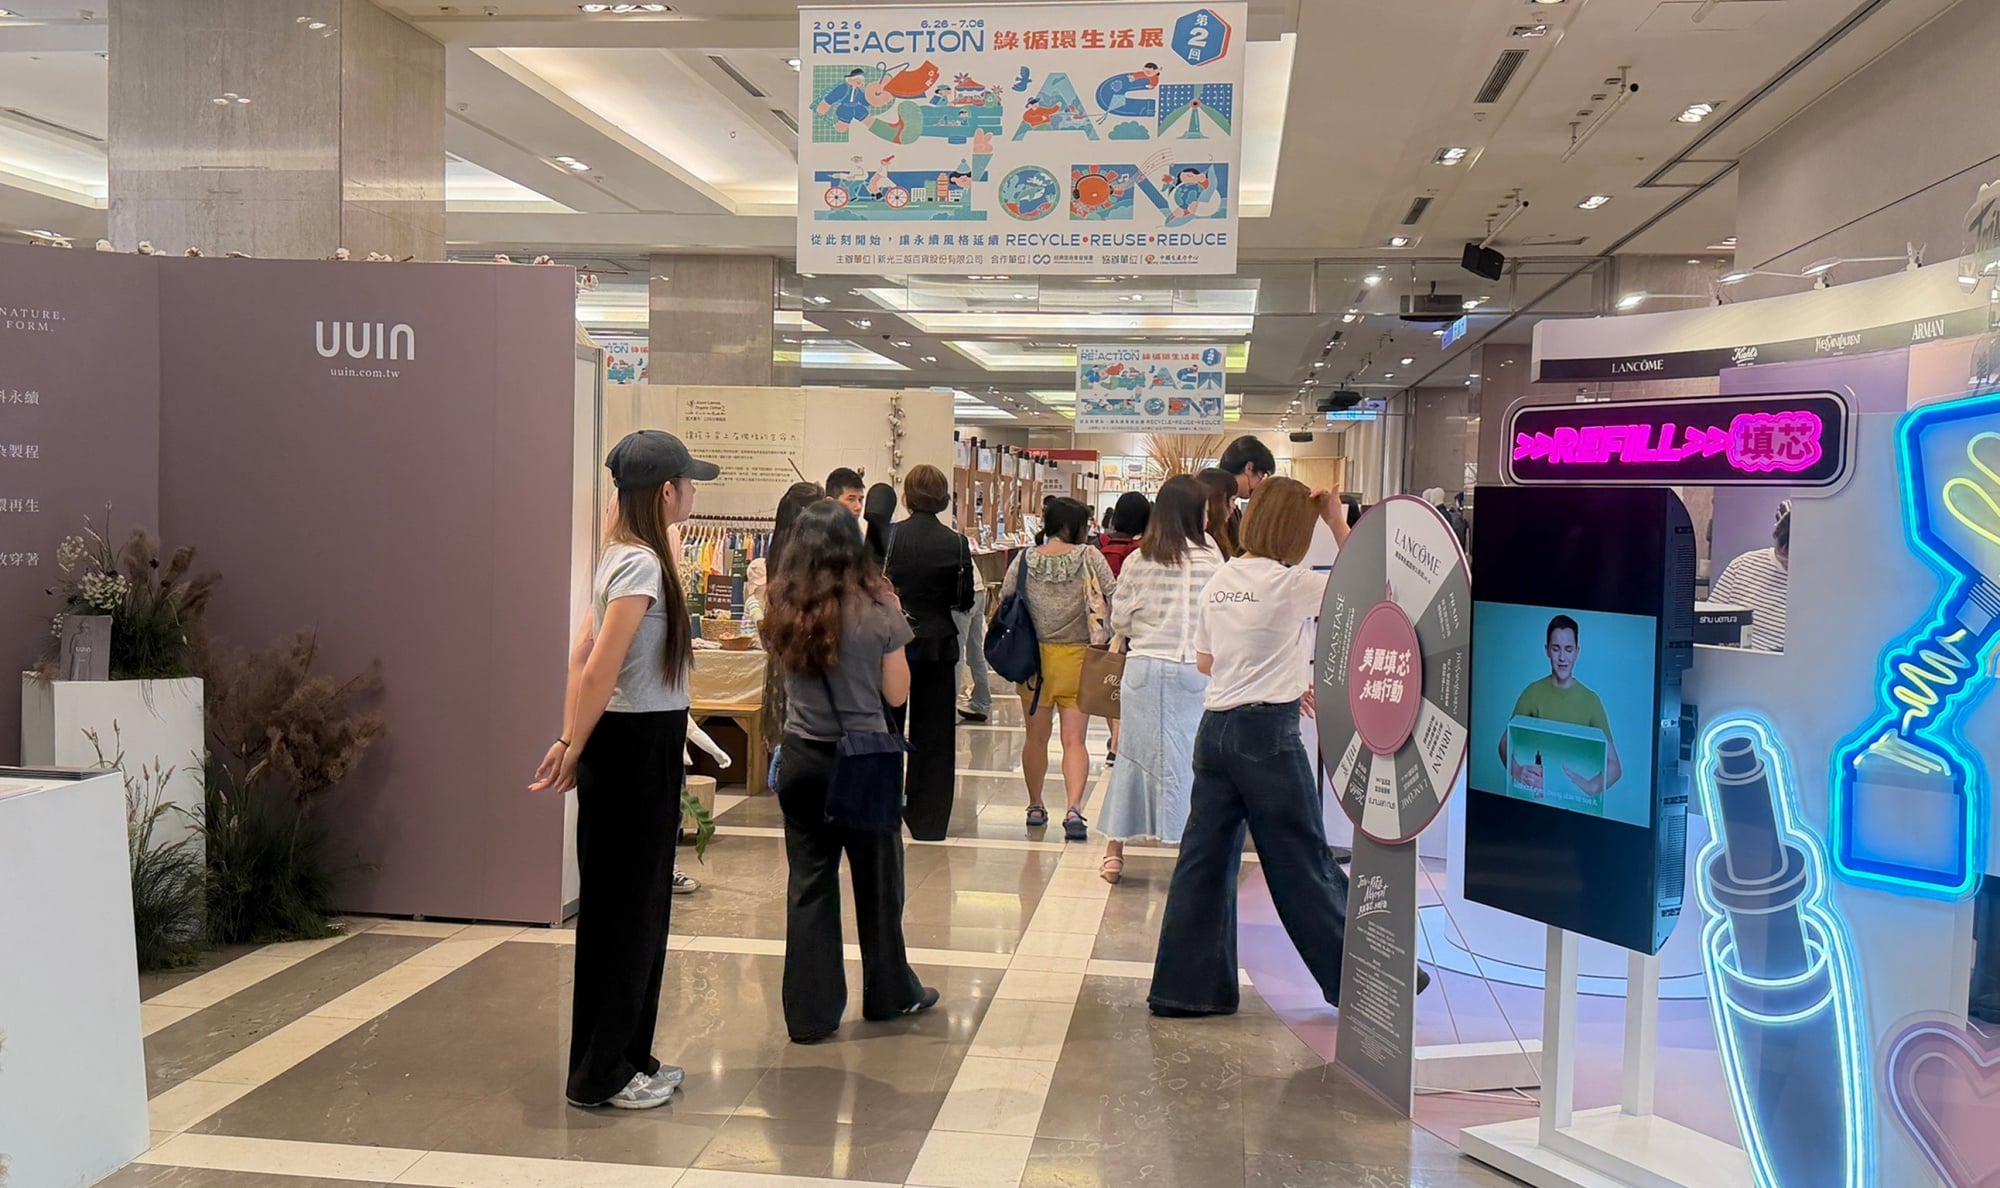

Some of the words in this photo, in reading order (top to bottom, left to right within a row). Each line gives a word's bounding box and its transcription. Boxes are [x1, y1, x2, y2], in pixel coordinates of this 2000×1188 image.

[812, 30, 985, 54] RE:ACTION
[993, 27, 1165, 50] 綠循環生活展
[1006, 233, 1081, 246] RECYCLE
[1091, 233, 1147, 246] REUSE
[1157, 232, 1227, 246] REDUCE
[6, 320, 54, 332] FORM.
[330, 367, 400, 378] uuin.com.tw
[1612, 359, 1664, 373] LANCÔME
[1741, 423, 1813, 462] 填芯
[1394, 528, 1442, 576] LANCÔME
[1358, 647, 1411, 676] 美麗填芯
[1359, 677, 1404, 703] 永續行動
